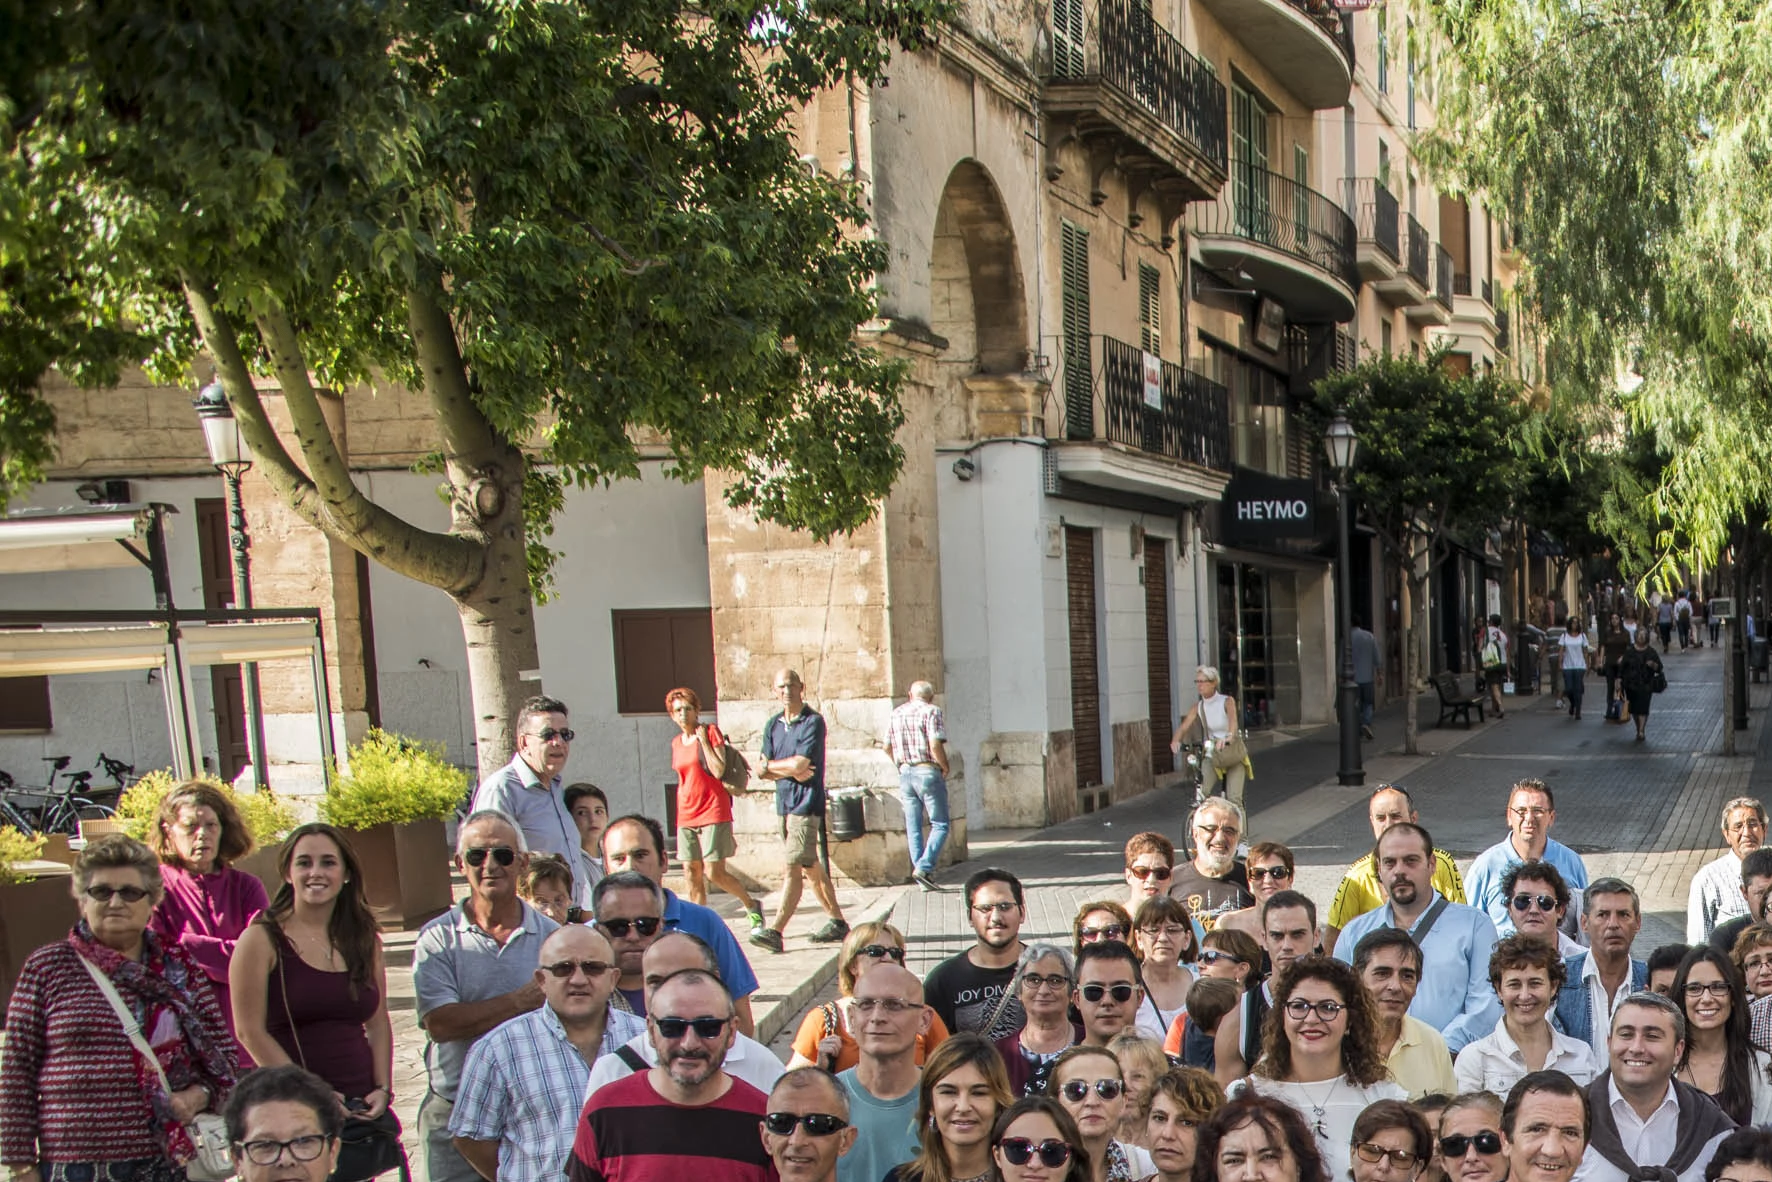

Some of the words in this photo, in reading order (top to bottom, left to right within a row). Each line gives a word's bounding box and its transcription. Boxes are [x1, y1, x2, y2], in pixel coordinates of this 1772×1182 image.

[1237, 500, 1307, 520] HEYMO
[954, 988, 981, 1004] JOY
[984, 984, 1007, 998] DIV
